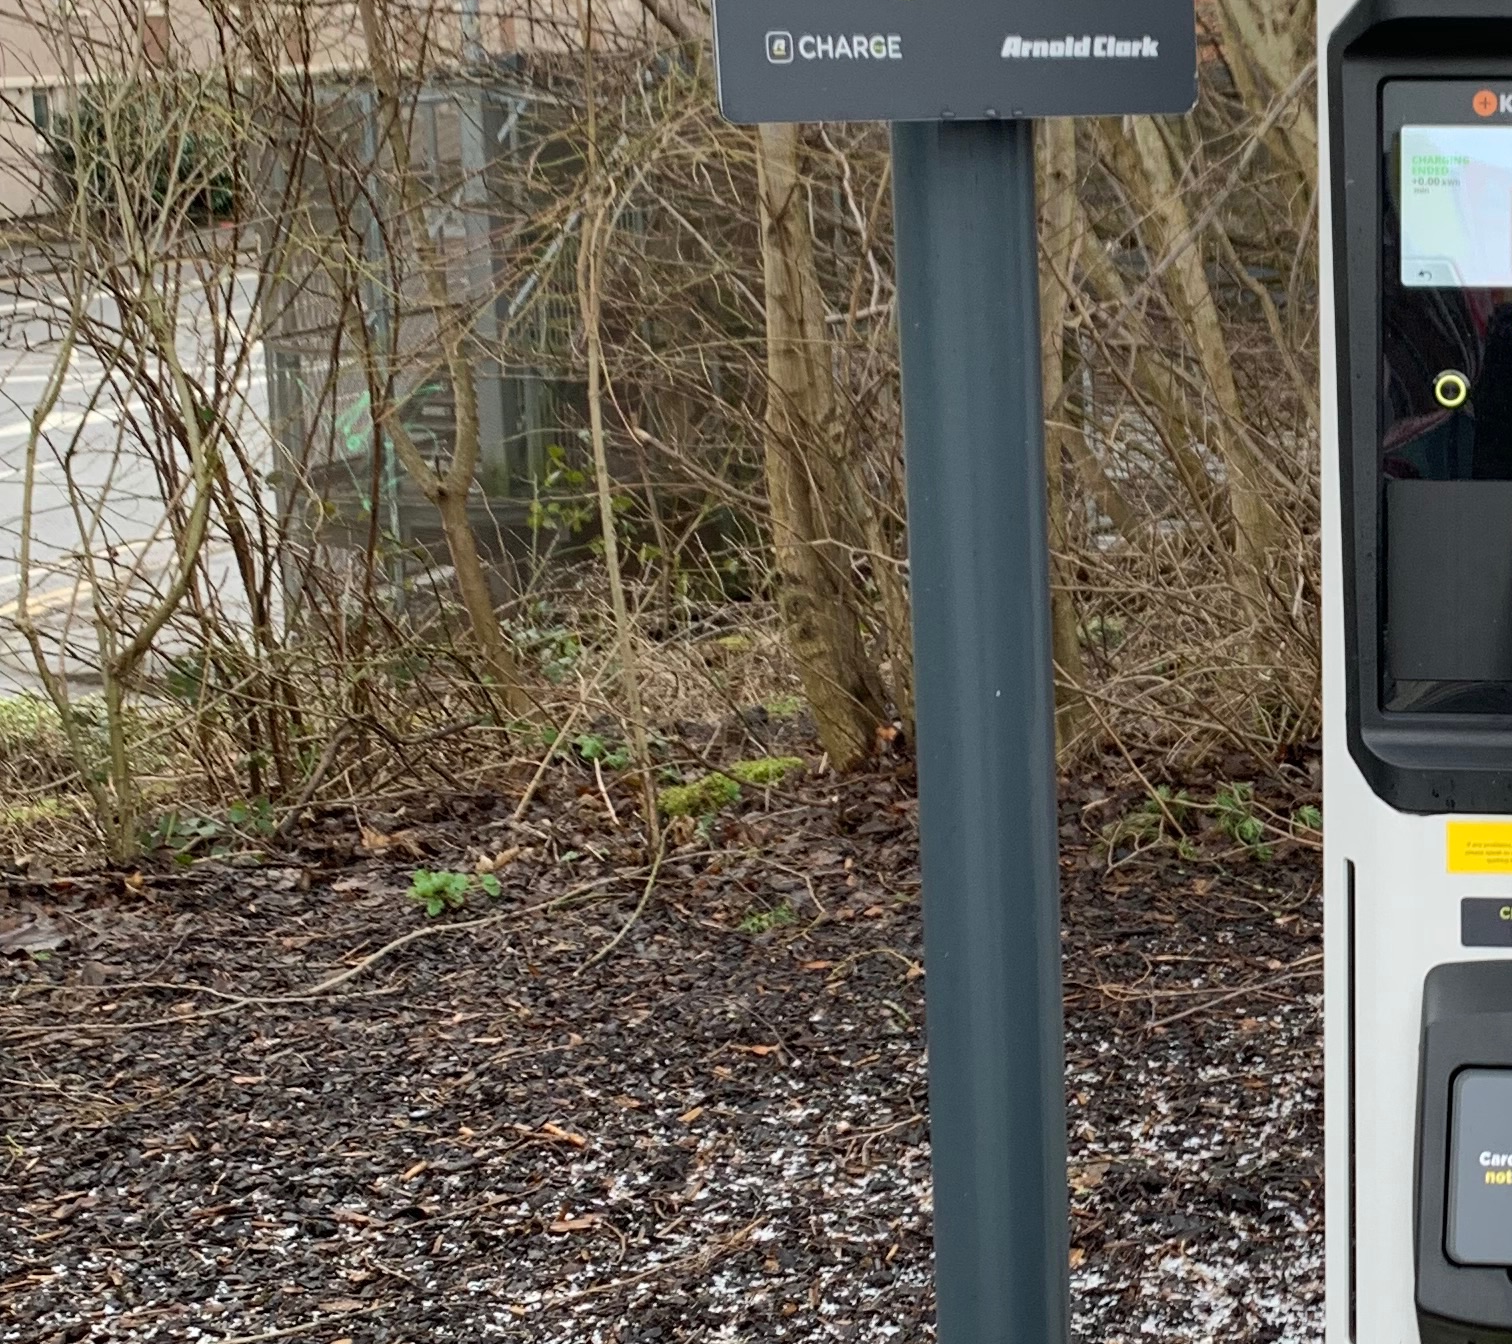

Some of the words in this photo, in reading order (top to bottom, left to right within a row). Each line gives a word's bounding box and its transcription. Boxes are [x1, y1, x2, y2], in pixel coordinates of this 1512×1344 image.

[799, 35, 902, 59] CHARGE
[1001, 36, 1091, 58] Arnold
[1093, 36, 1159, 58] Clark
[1412, 156, 1470, 166] CHARGING
[1412, 166, 1449, 176] ENDED
[1485, 1168, 1512, 1184] not
